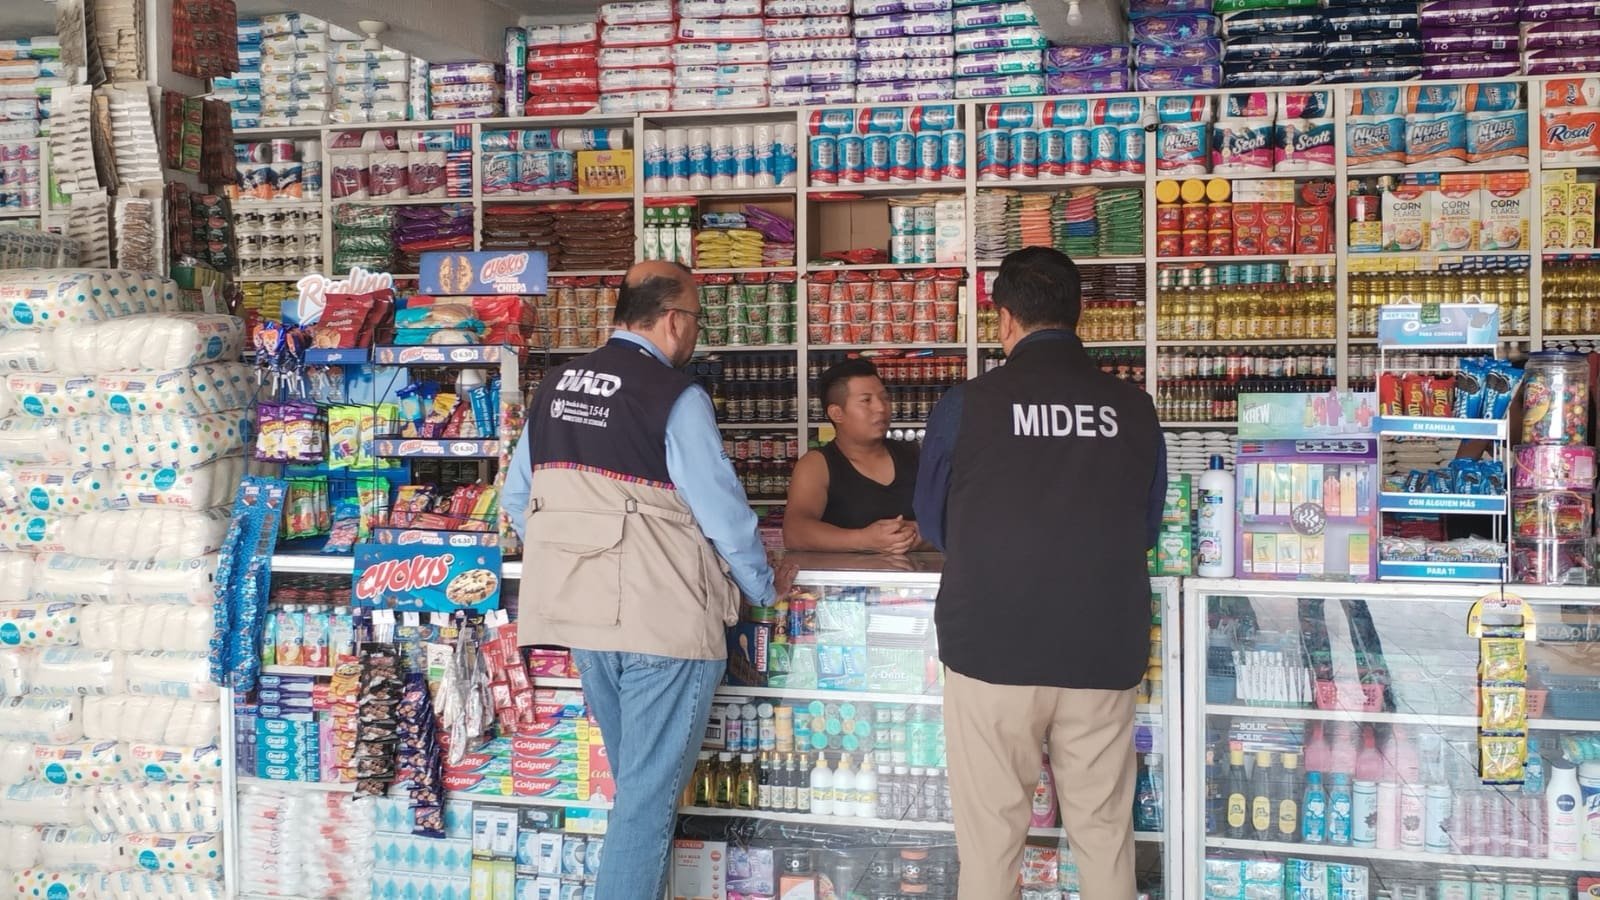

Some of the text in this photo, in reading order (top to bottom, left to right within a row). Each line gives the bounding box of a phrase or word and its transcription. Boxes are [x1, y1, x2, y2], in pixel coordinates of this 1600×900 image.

[1355, 125, 1388, 139] NUBE
[1413, 121, 1448, 137] NUBE
[1479, 120, 1513, 136] NUBE
[1547, 121, 1596, 143] Rosal
[1166, 131, 1198, 145] NUBE
[1233, 136, 1266, 154] Scott
[1296, 131, 1331, 150] Scott
[1393, 202, 1421, 210] CORN
[1442, 201, 1470, 209] CORN
[1491, 200, 1519, 208] CORN
[482, 253, 528, 282] CHOKIS
[555, 369, 622, 398] DIACO
[590, 405, 610, 418] 1544
[1012, 403, 1119, 438] MIDES
[1425, 423, 1455, 431] FAMILIA
[1408, 498, 1476, 508] CON ALGUIEN MÁS
[356, 554, 454, 599] CHOKIS
[1426, 567, 1447, 575] PARA
[514, 741, 551, 751] Colgate
[515, 760, 551, 770] Colgate
[514, 779, 551, 790] Colgate
